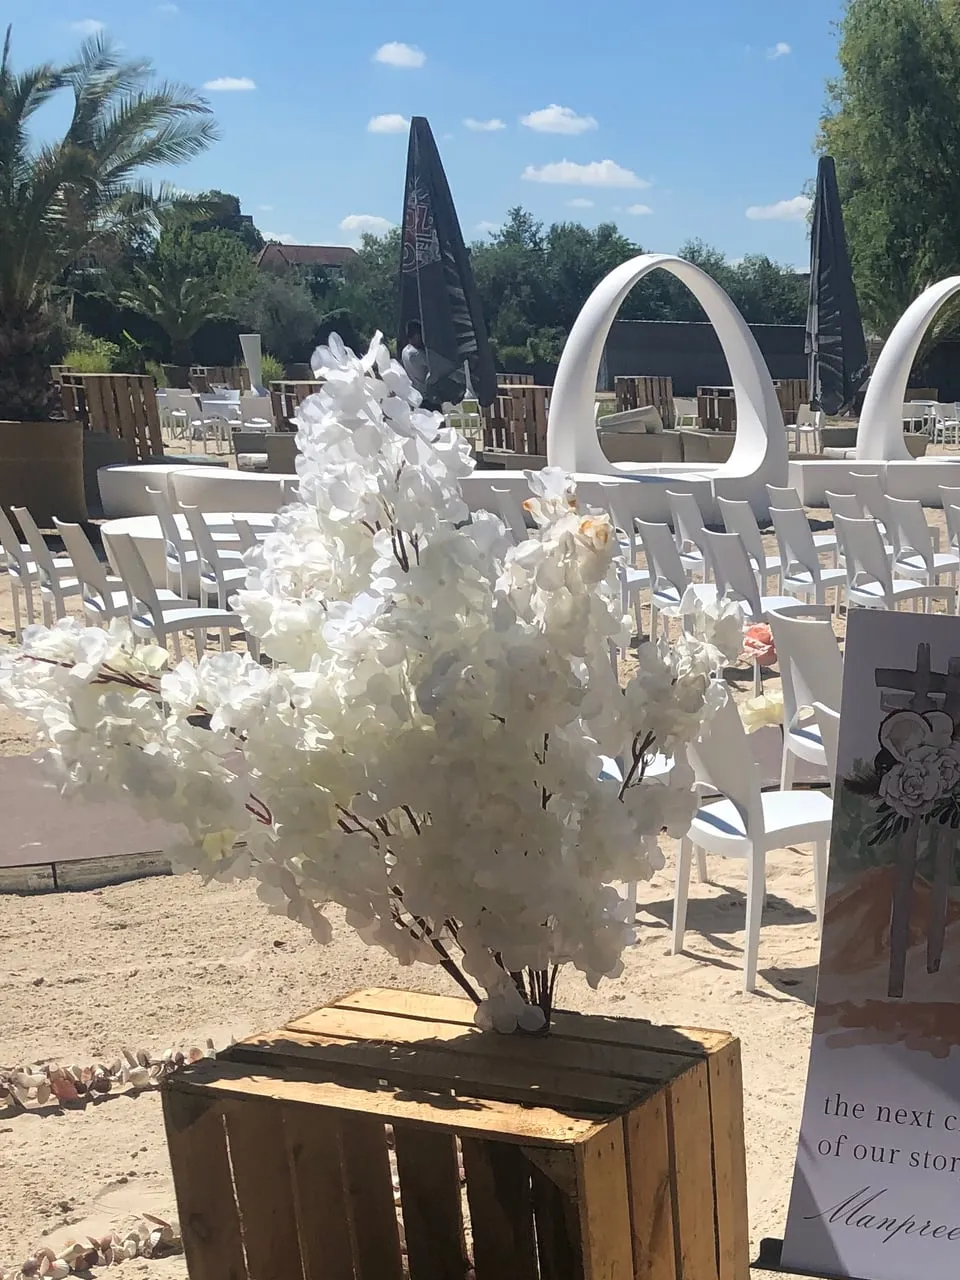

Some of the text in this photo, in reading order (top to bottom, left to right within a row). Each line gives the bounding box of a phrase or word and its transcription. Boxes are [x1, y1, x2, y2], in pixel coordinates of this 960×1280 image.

[824, 1094, 865, 1119] the
[876, 1103, 934, 1128] next
[818, 1135, 849, 1157] of
[853, 1143, 901, 1163] our
